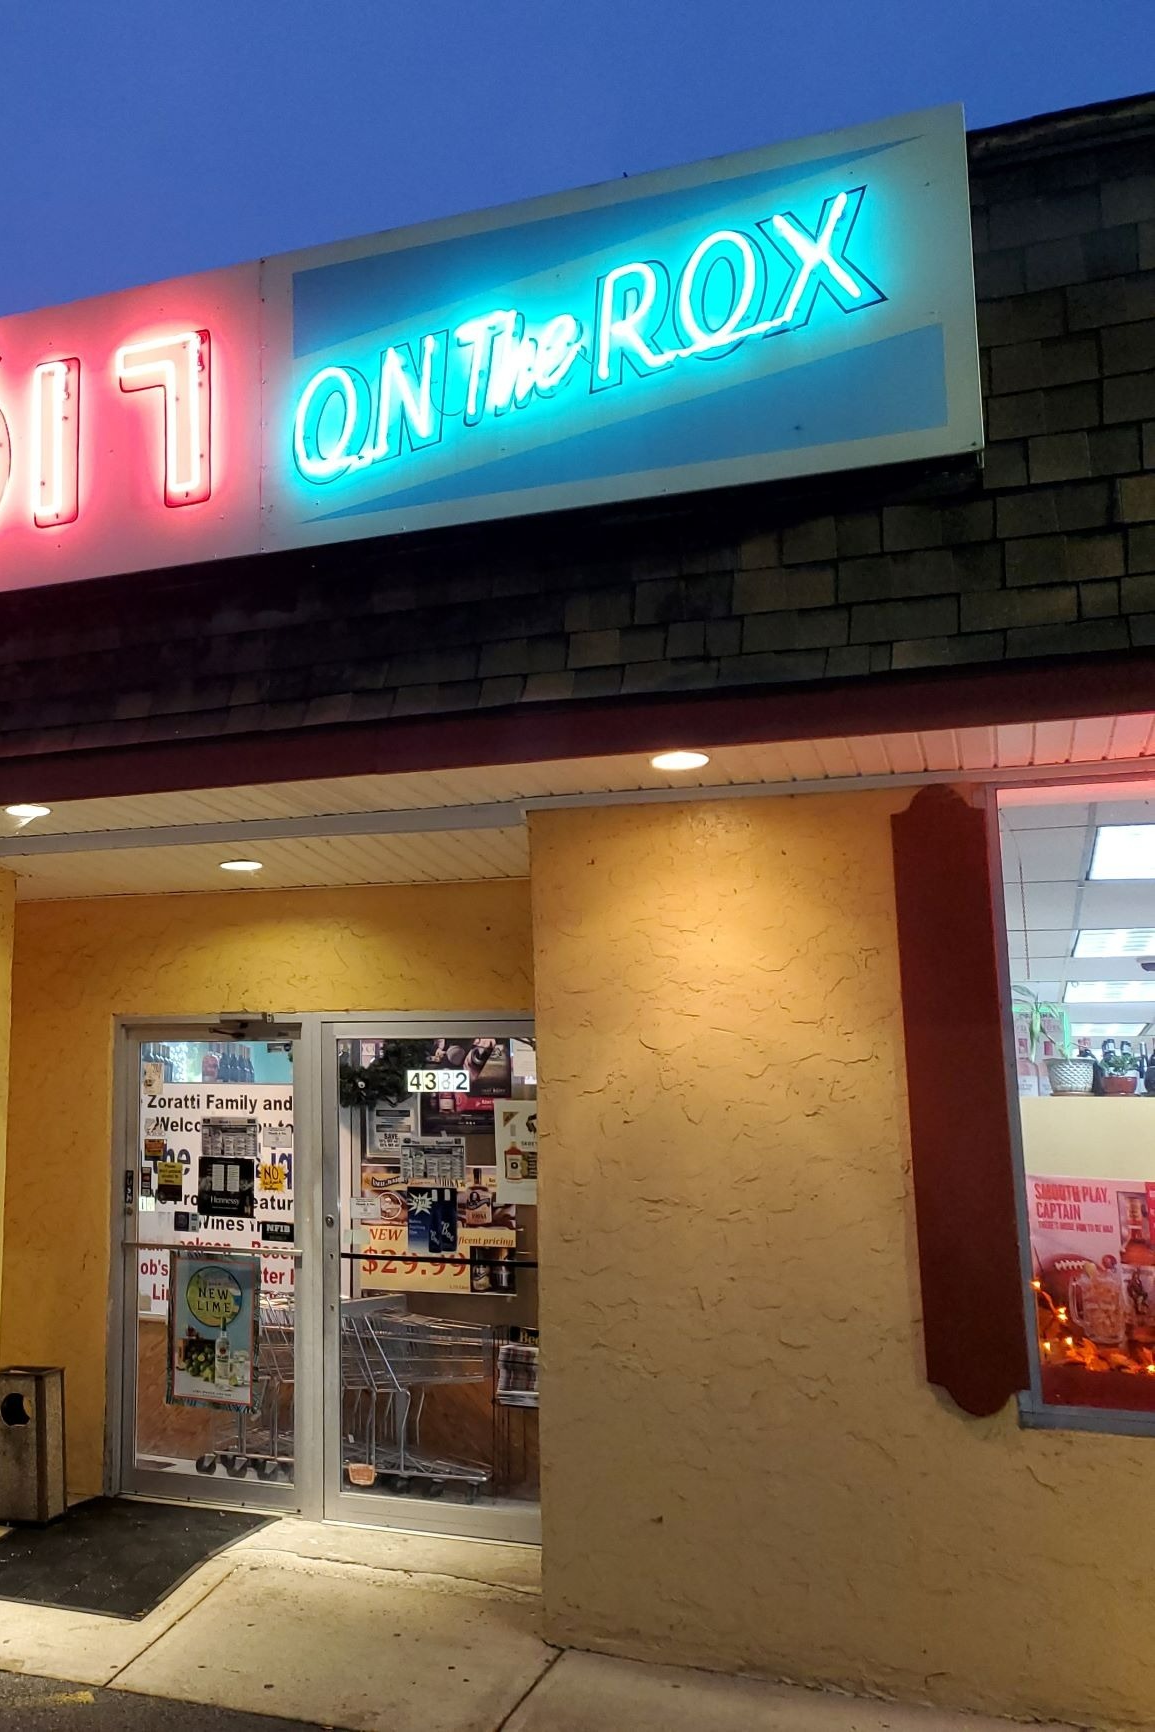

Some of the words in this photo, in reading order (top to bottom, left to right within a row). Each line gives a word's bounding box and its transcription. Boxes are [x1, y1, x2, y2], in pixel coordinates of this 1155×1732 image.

[293, 330, 449, 485] ON
[454, 308, 587, 427] The
[589, 184, 889, 394] ROX
[147, 1094, 200, 1109] Zoratti
[206, 1094, 258, 1115] Family
[262, 1095, 293, 1111] and
[263, 1165, 279, 1180] NO
[1036, 1202, 1081, 1220] CAPTAIN
[266, 1223, 291, 1234] NFIB
[457, 1235, 482, 1247] ficent
[482, 1235, 514, 1248] pricing
[140, 1258, 169, 1276] ob's
[198, 1286, 229, 1300] NEW
[197, 1301, 231, 1313] LIME
